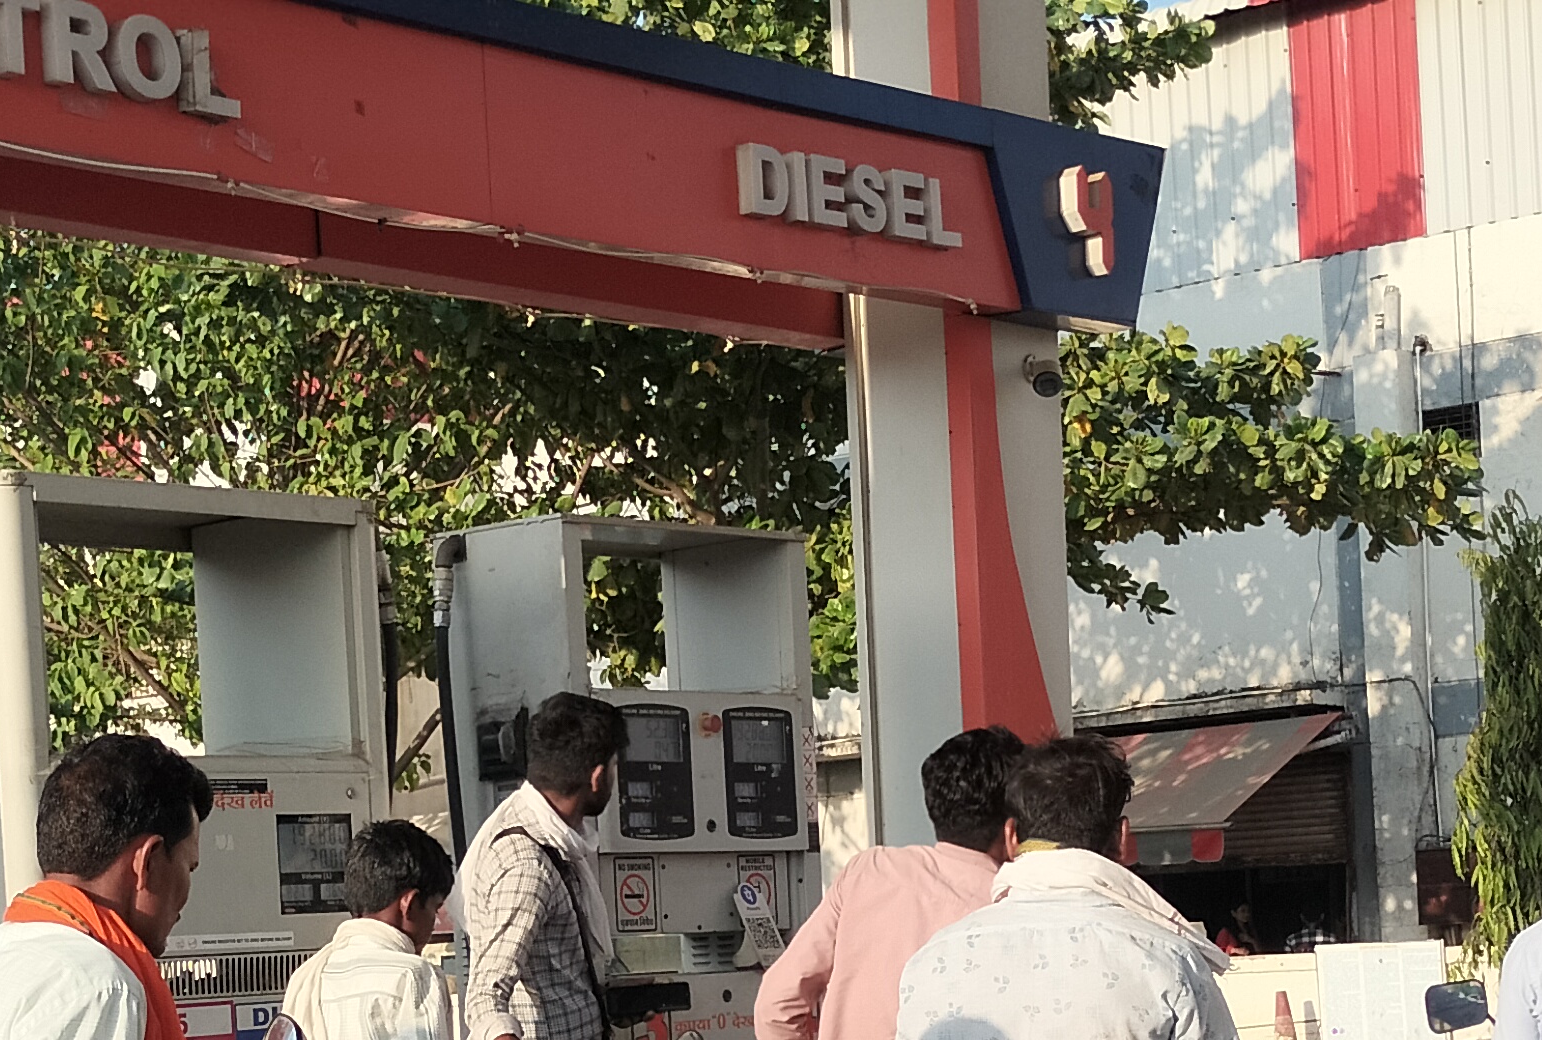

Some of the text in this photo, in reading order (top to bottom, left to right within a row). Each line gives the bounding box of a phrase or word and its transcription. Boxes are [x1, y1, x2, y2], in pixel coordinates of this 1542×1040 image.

[735, 142, 963, 249] DIESEL
[617, 863, 651, 871] NO SMOKING
